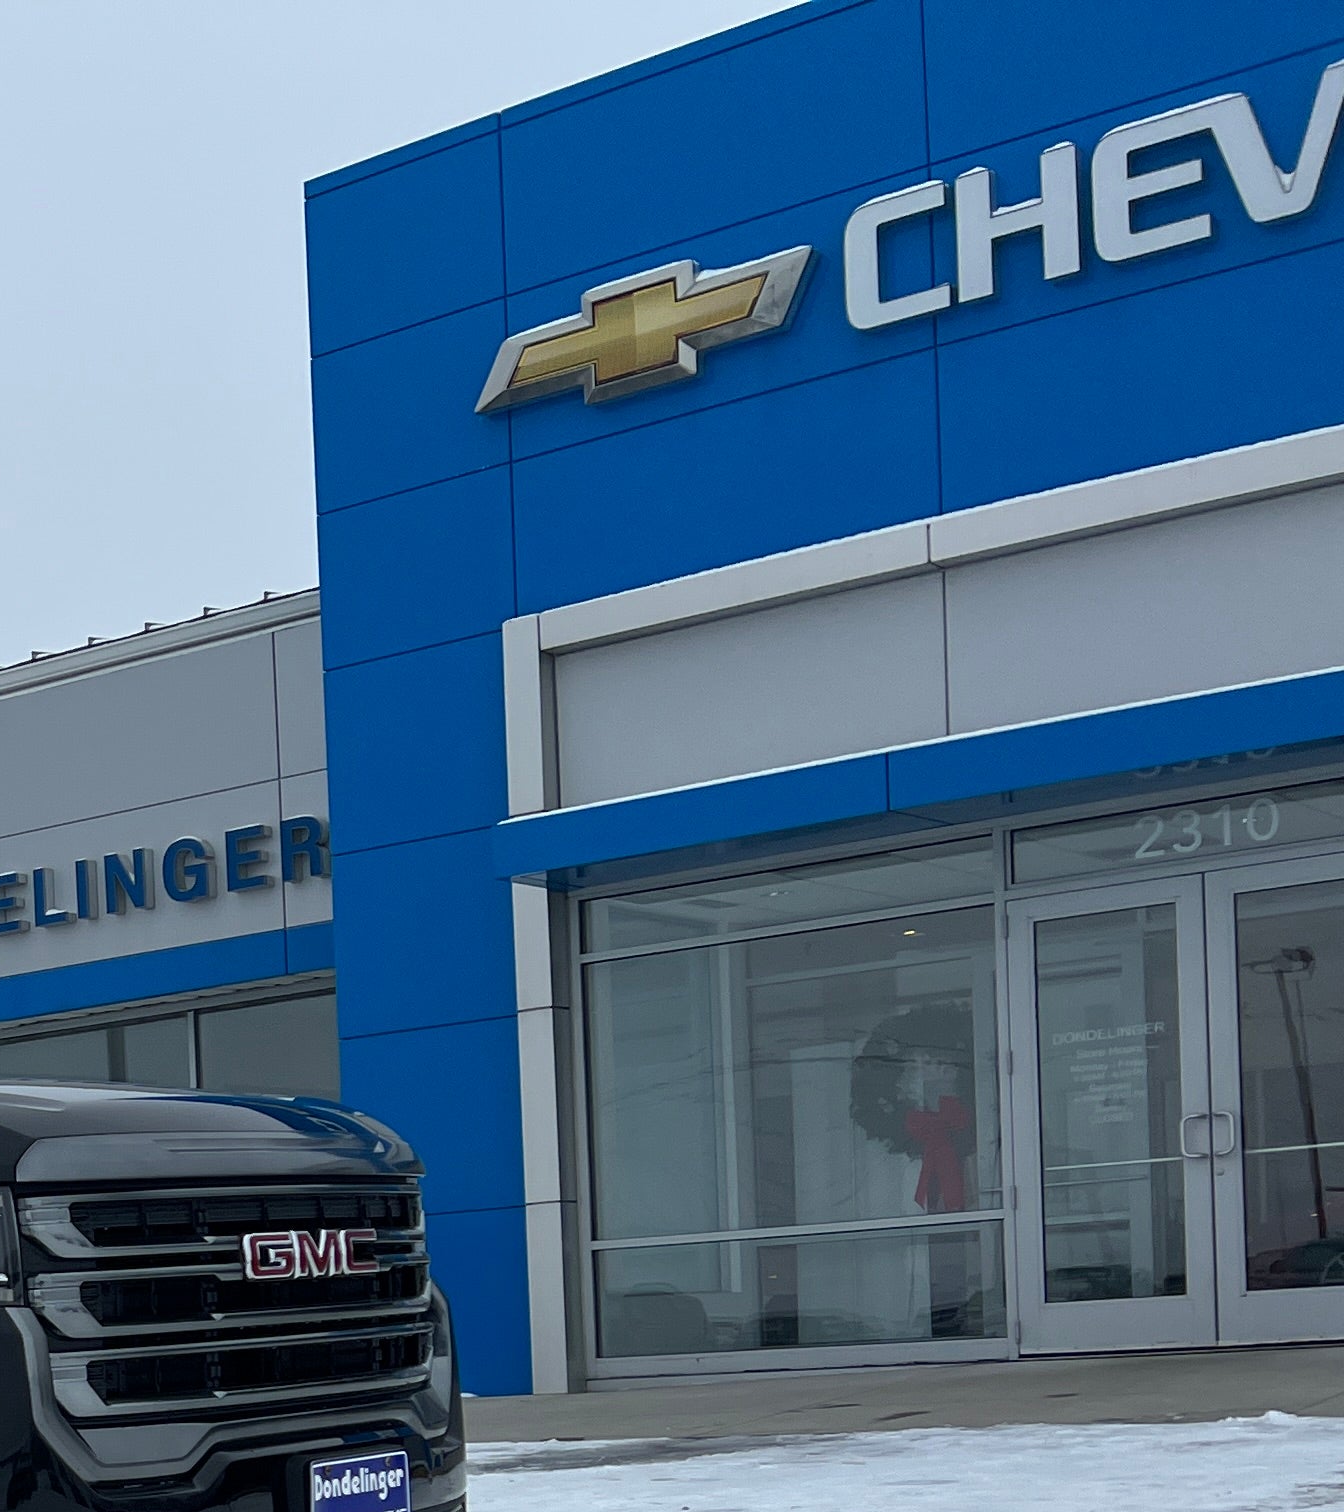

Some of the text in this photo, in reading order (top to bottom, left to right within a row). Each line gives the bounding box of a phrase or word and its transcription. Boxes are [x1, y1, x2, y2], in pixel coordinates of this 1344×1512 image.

[843, 58, 1344, 330] CHEV
[1134, 797, 1280, 859] 2310
[1052, 1021, 1165, 1045] DONDELINGER
[242, 1228, 380, 1279] GMC
[315, 1467, 405, 1501] Dondelinger
